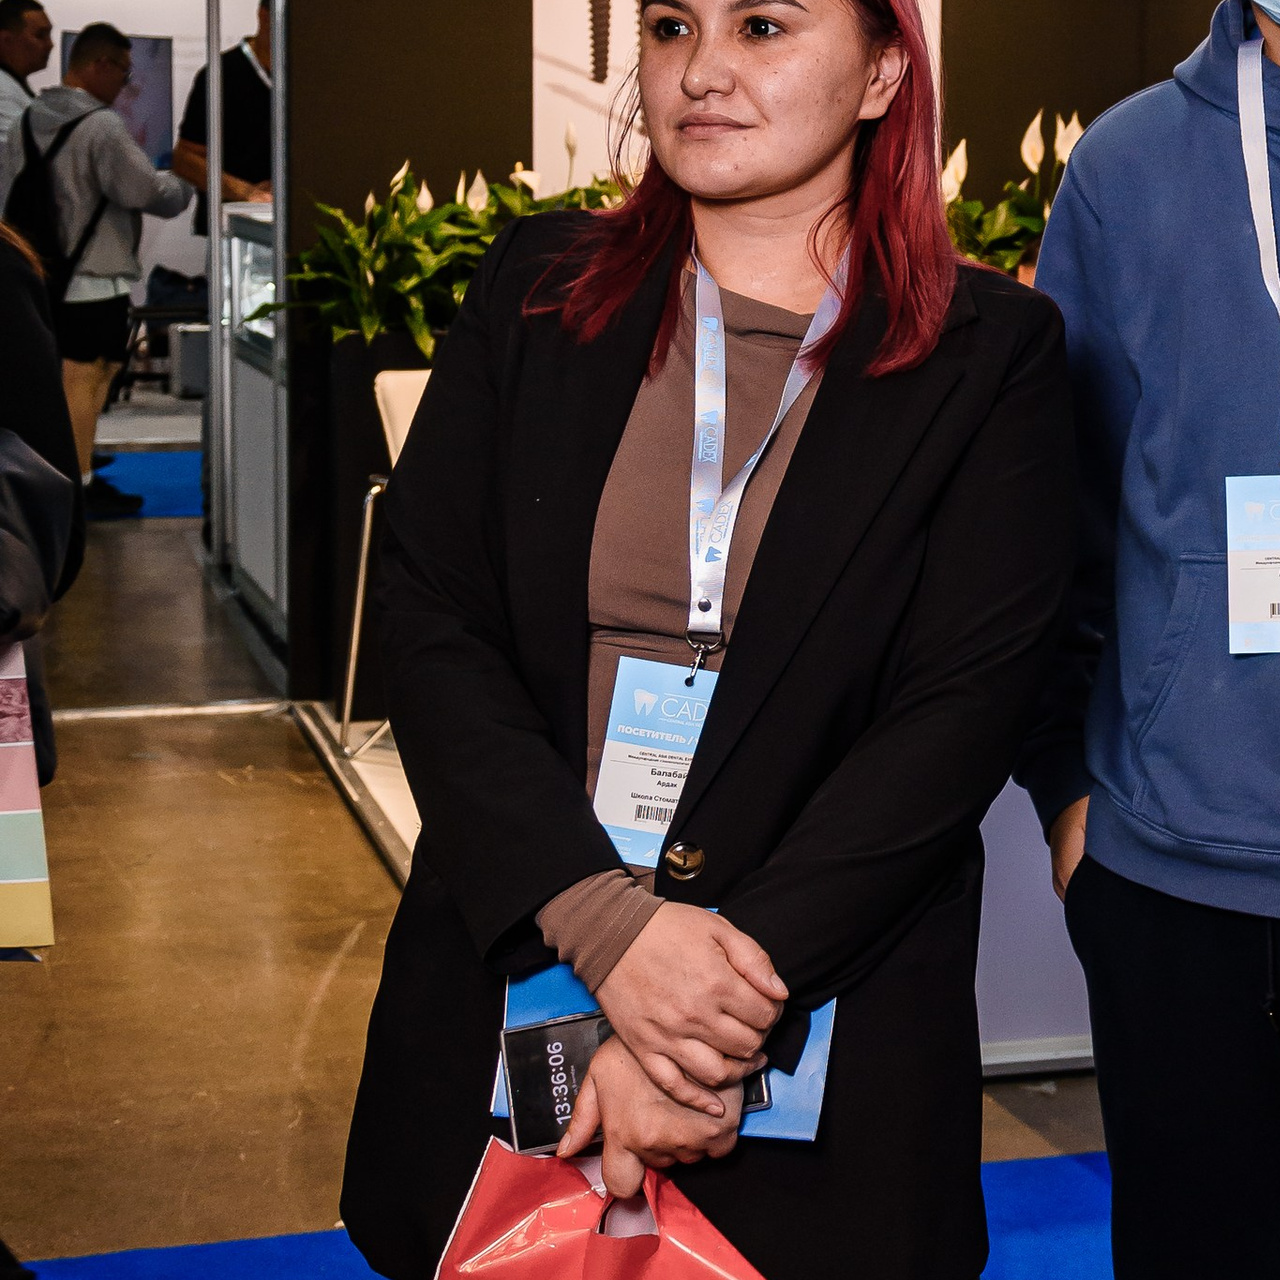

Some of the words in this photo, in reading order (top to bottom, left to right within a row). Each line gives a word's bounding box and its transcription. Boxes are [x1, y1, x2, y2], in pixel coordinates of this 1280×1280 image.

[702, 427, 717, 462] CADEX
[710, 500, 732, 544] CADEX
[661, 697, 708, 722] CAD
[617, 724, 686, 744] ПОСЕТИТЕЛЬ
[630, 792, 652, 801] Школа
[656, 780, 678, 788] Ардак
[547, 1041, 572, 1125] 13:36:06
